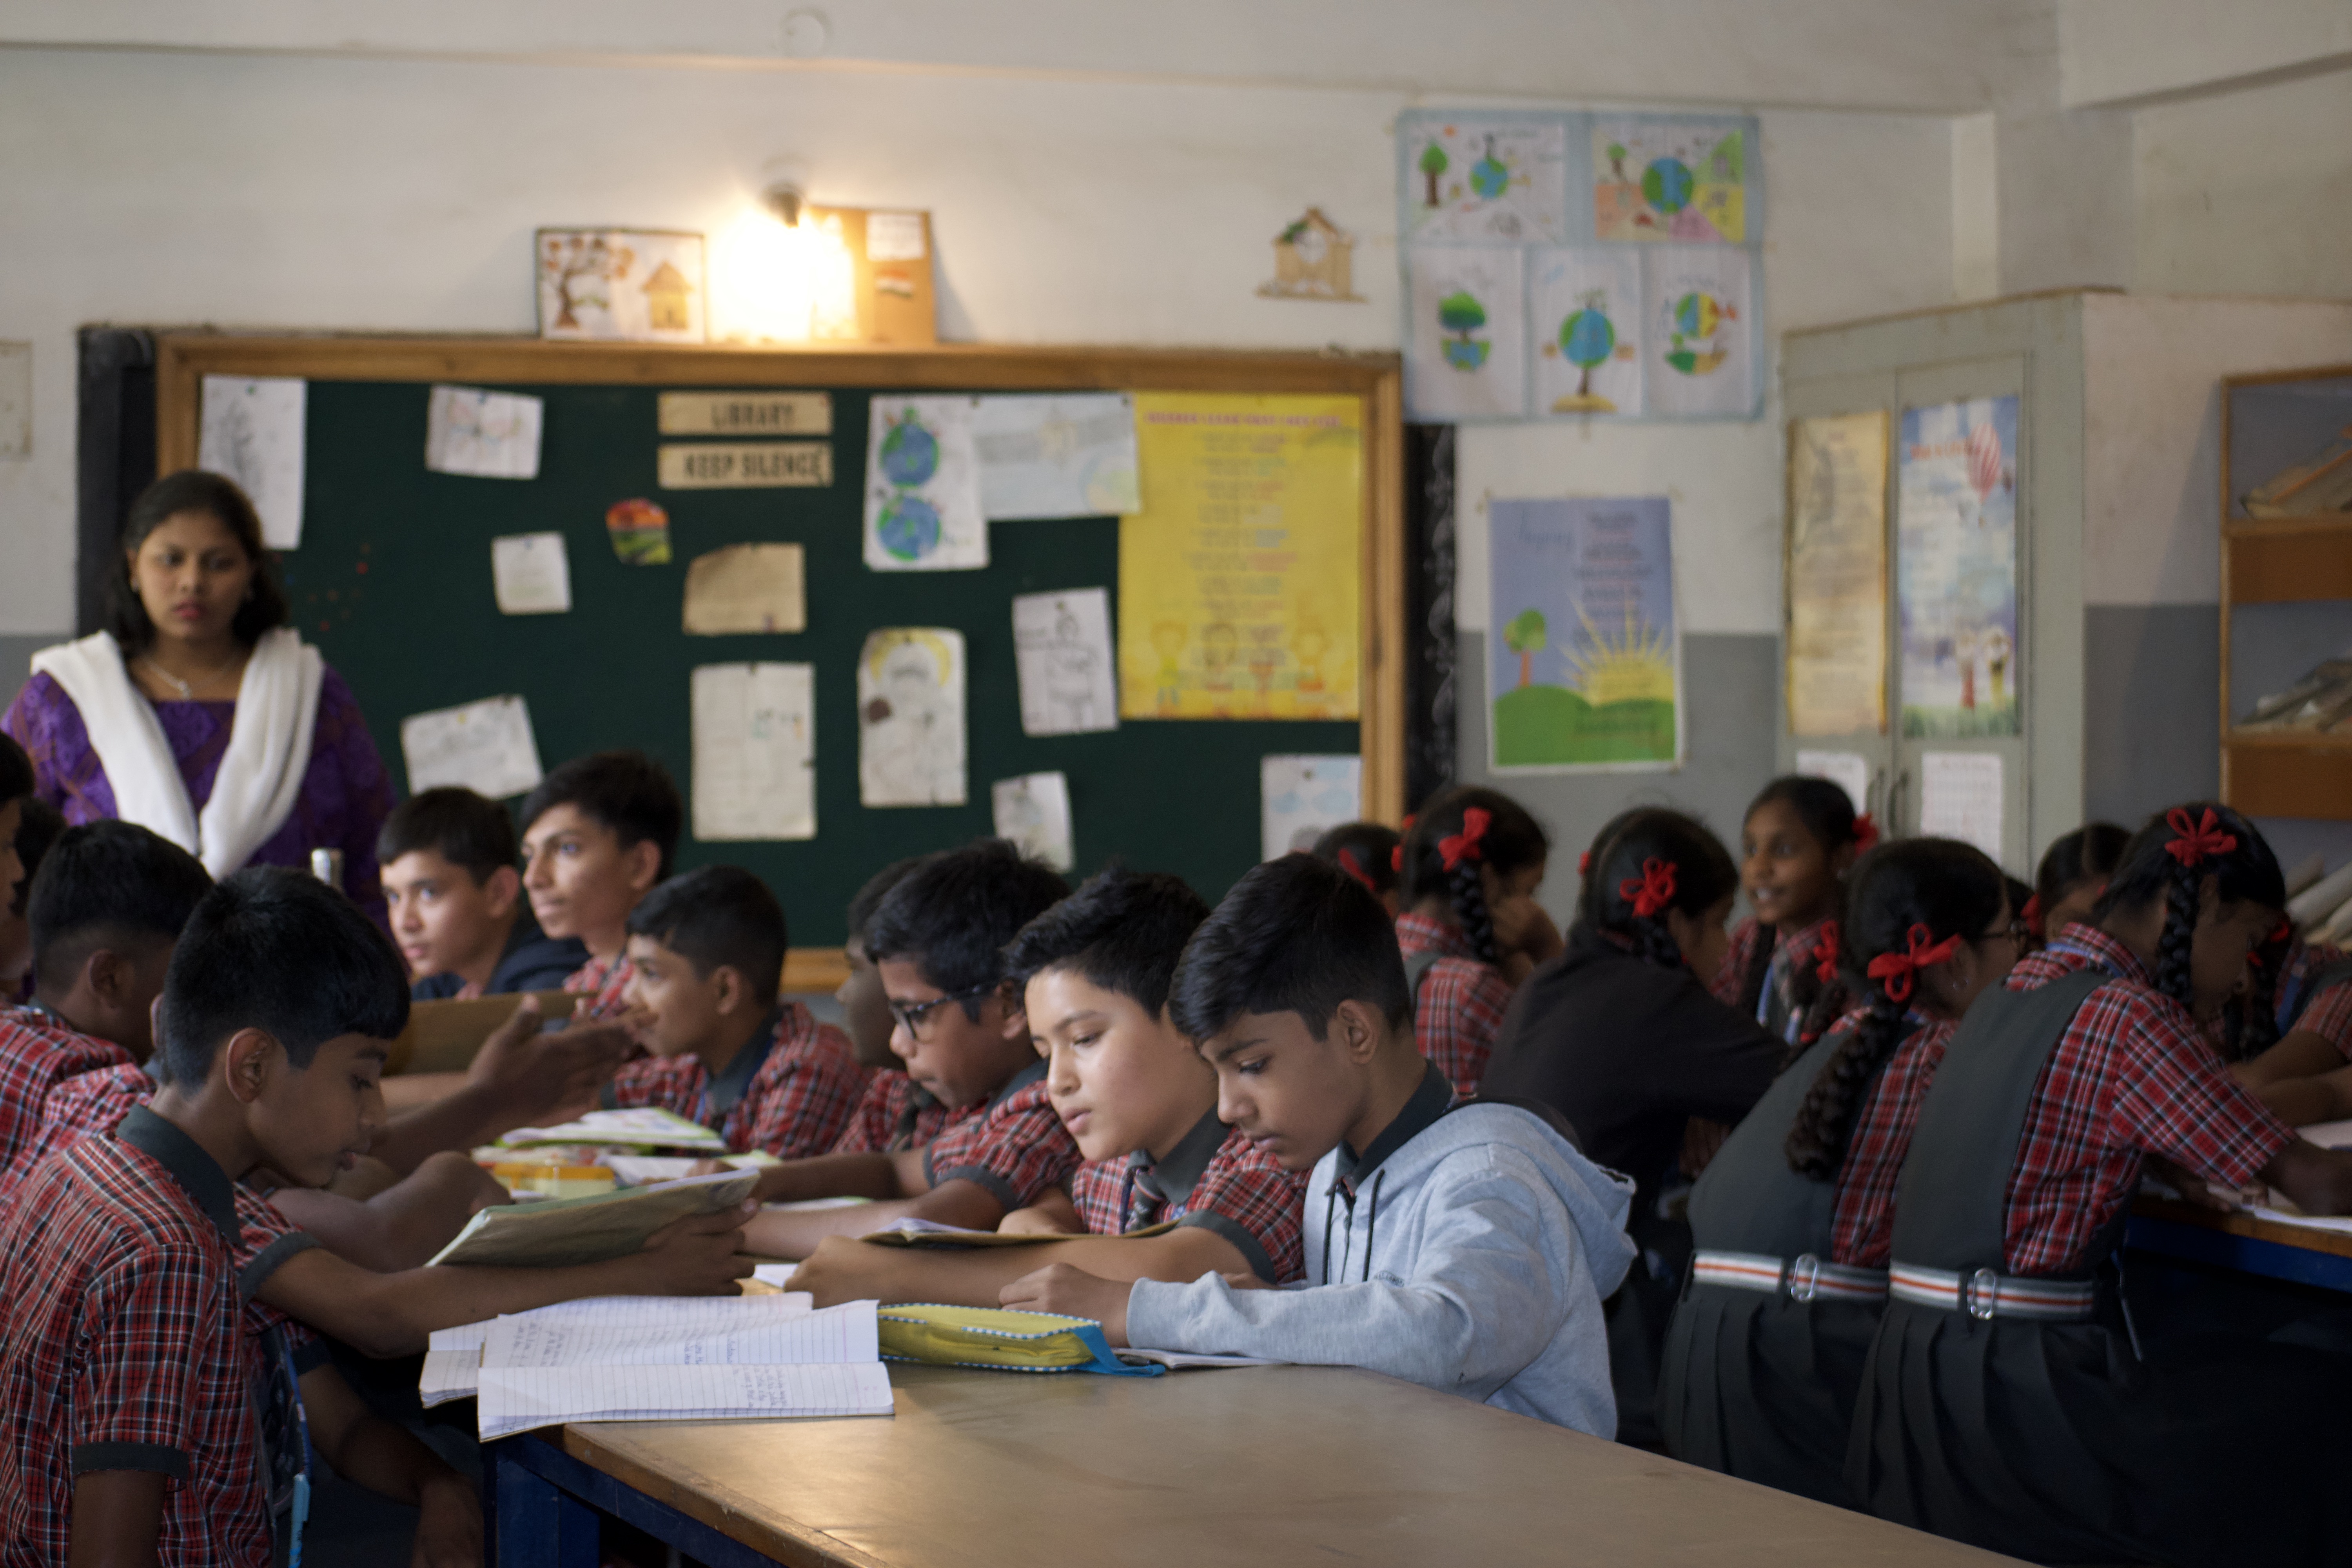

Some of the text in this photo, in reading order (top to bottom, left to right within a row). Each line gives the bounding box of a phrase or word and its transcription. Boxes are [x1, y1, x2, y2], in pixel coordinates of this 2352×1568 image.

[710, 402, 794, 426] LIBRARY
[684, 452, 820, 478] KEEP SILENCE
